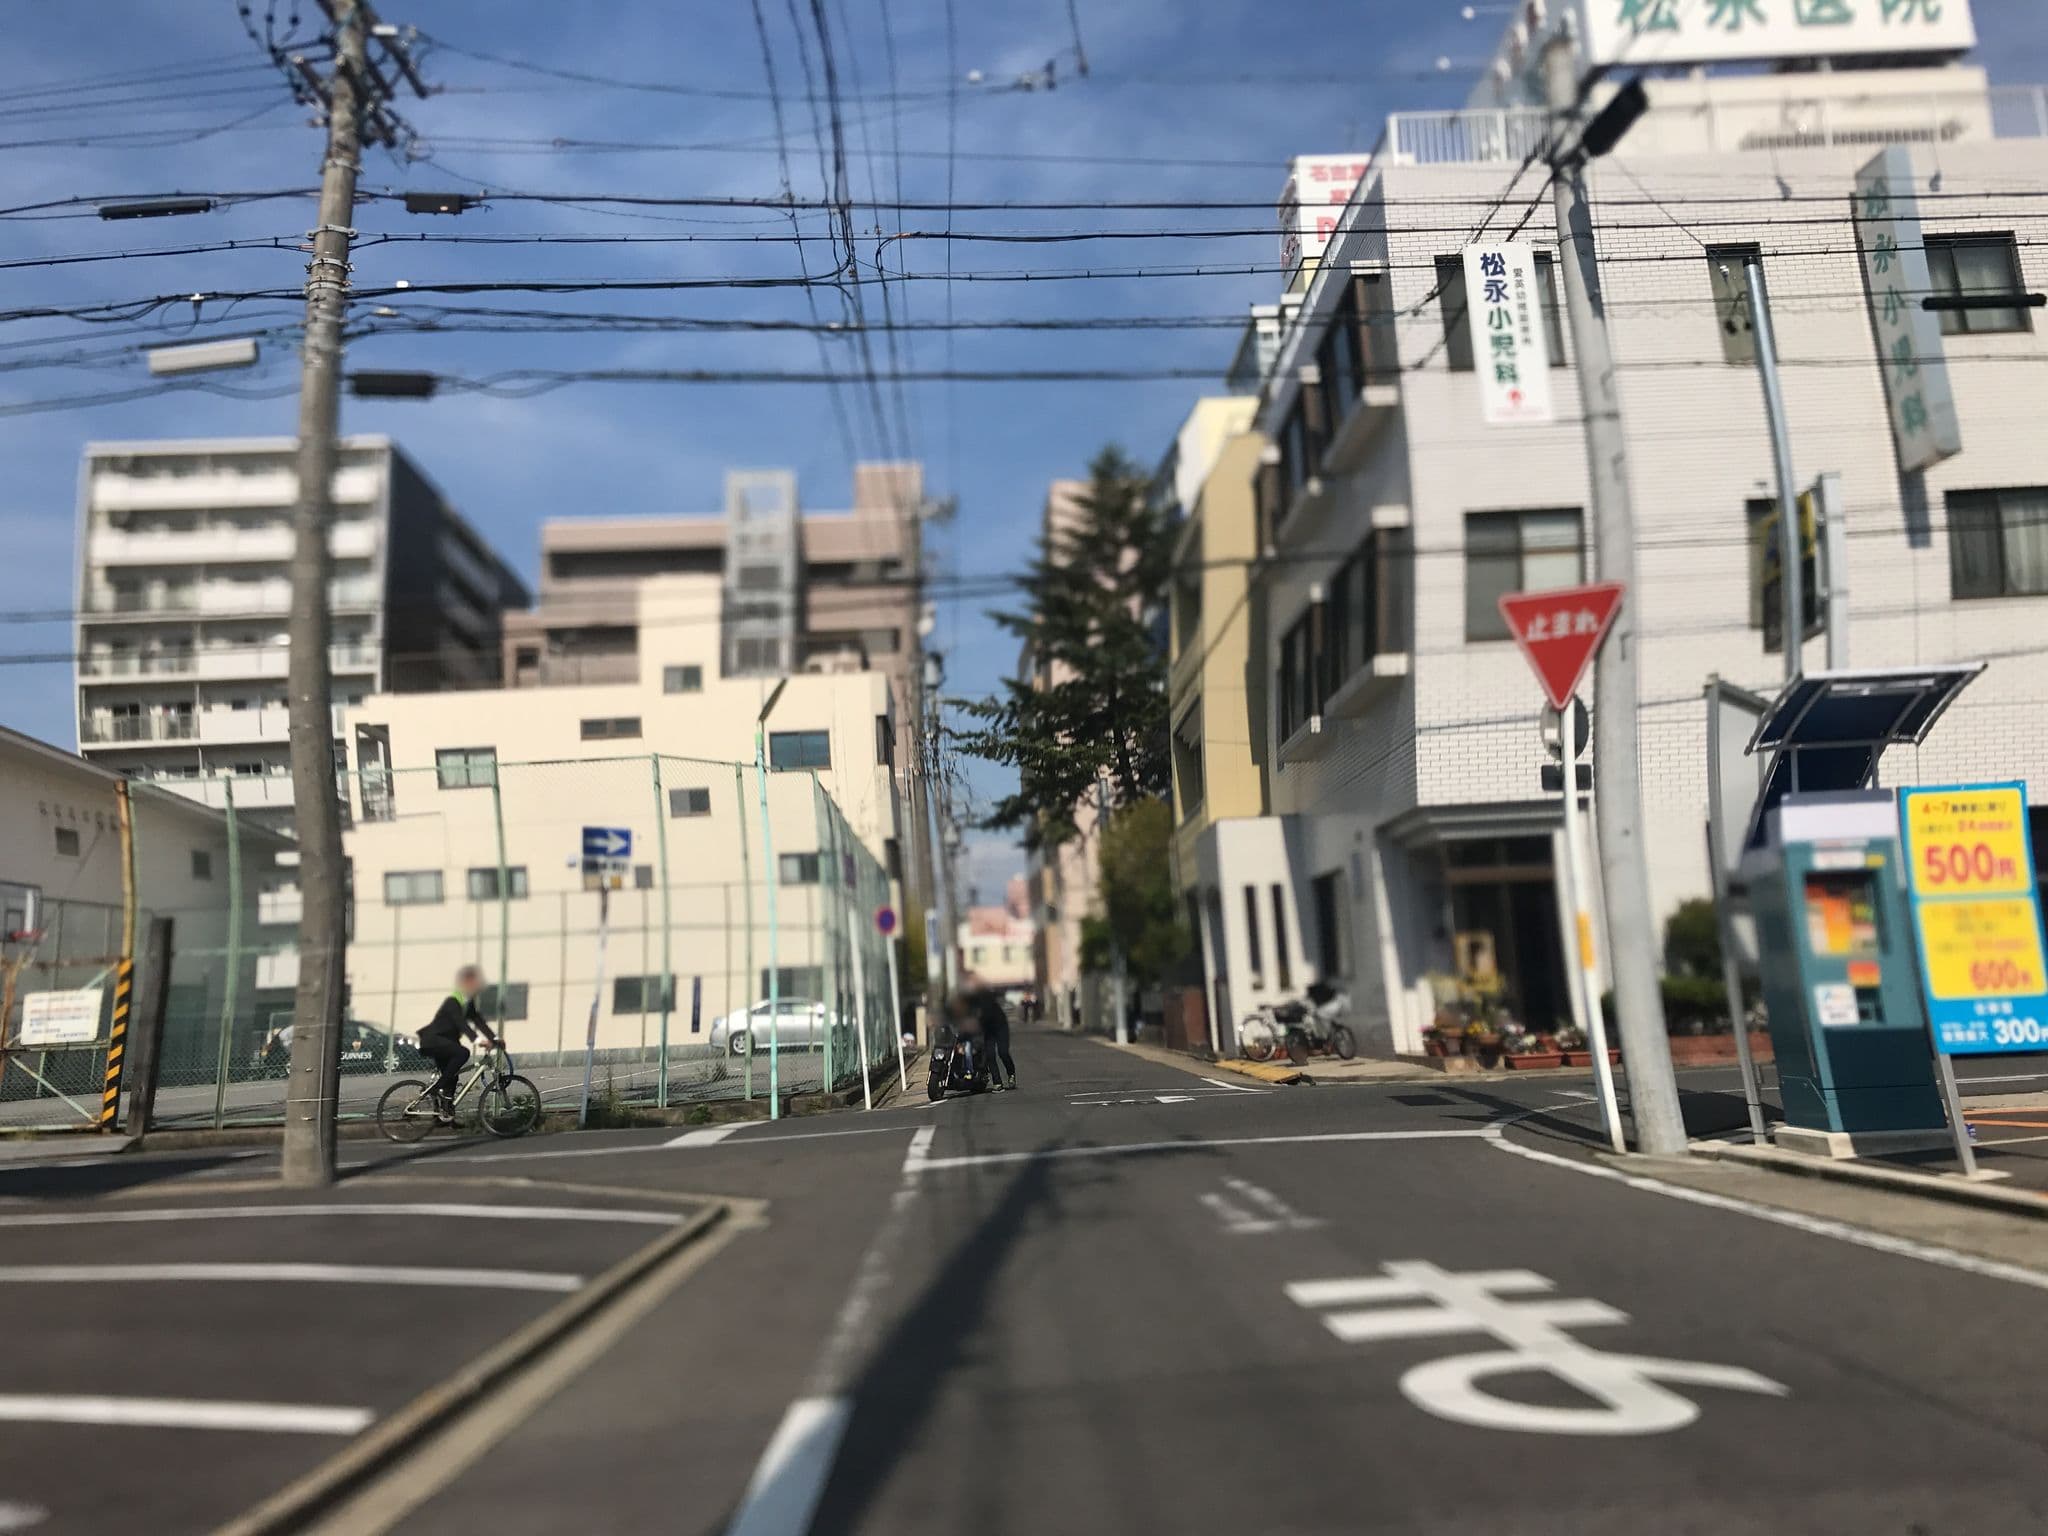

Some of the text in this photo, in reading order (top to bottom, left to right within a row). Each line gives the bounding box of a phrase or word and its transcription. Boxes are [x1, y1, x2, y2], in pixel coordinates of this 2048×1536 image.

[1480, 252, 1520, 385] 松永小児科
[1864, 176, 1927, 437] 松永小児科
[1526, 608, 1600, 642] 止まれ
[1924, 842, 2017, 886] 500円
